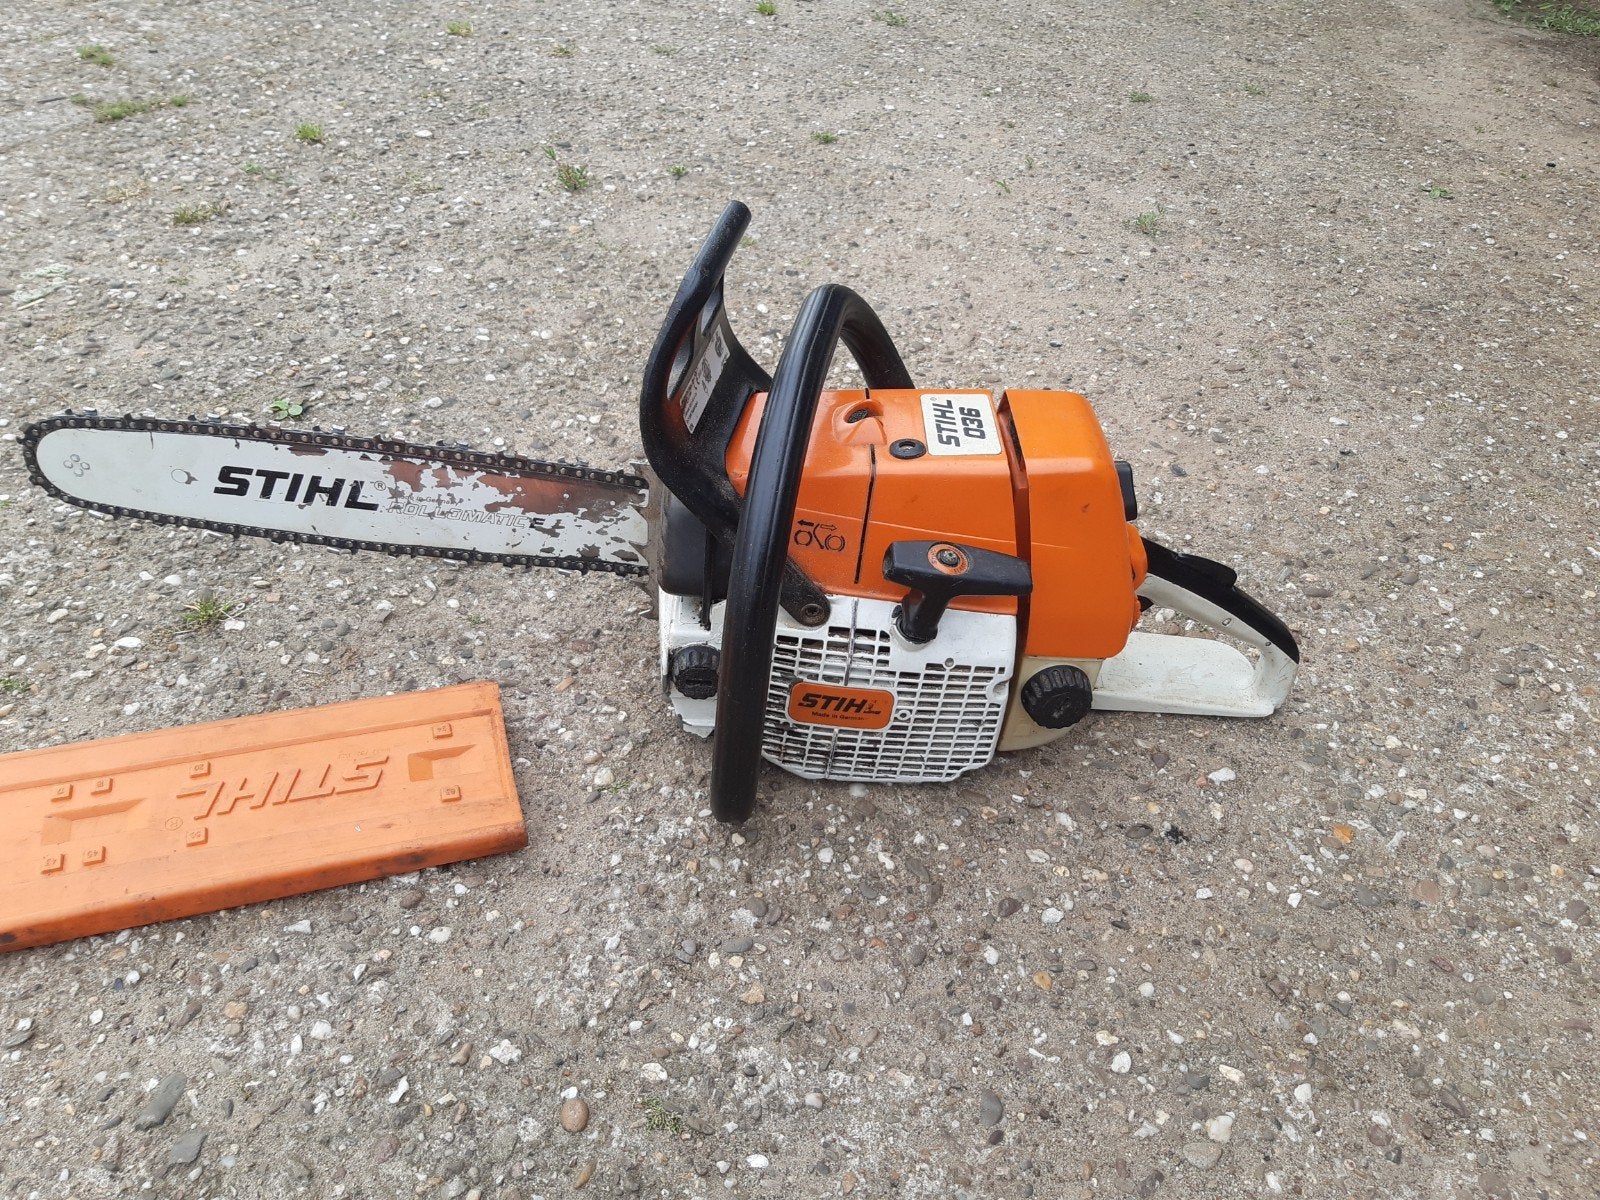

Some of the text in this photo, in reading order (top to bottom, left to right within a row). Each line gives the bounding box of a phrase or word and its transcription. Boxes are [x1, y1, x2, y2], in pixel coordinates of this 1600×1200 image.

[932, 399, 960, 448] STIHL
[958, 406, 986, 440] 036
[214, 465, 380, 511] STIHL
[176, 756, 390, 822] STIHL
